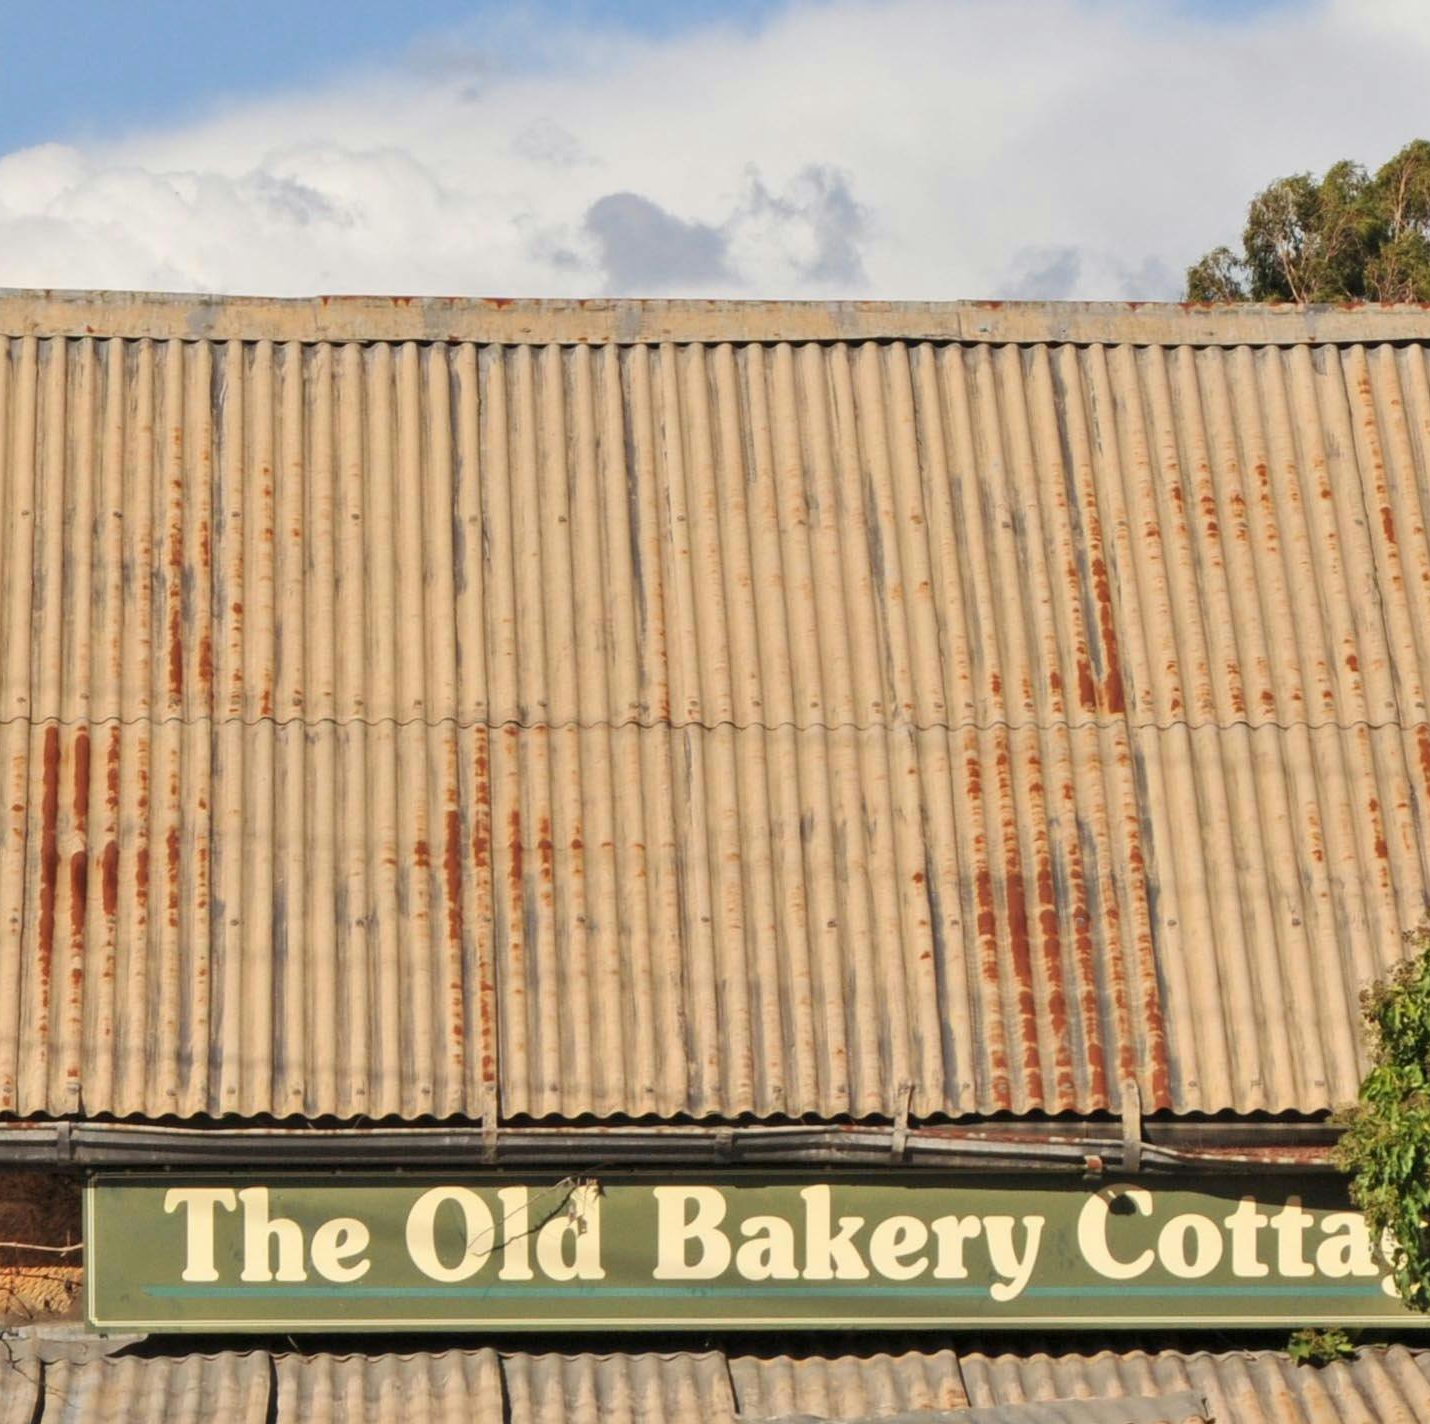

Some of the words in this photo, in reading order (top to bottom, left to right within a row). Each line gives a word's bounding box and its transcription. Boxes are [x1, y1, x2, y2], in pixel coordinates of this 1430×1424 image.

[163, 1187, 371, 1283] The
[405, 1185, 606, 1283] Old
[652, 1184, 1046, 1302] Bakery
[1077, 1183, 1421, 1298] Cotta
